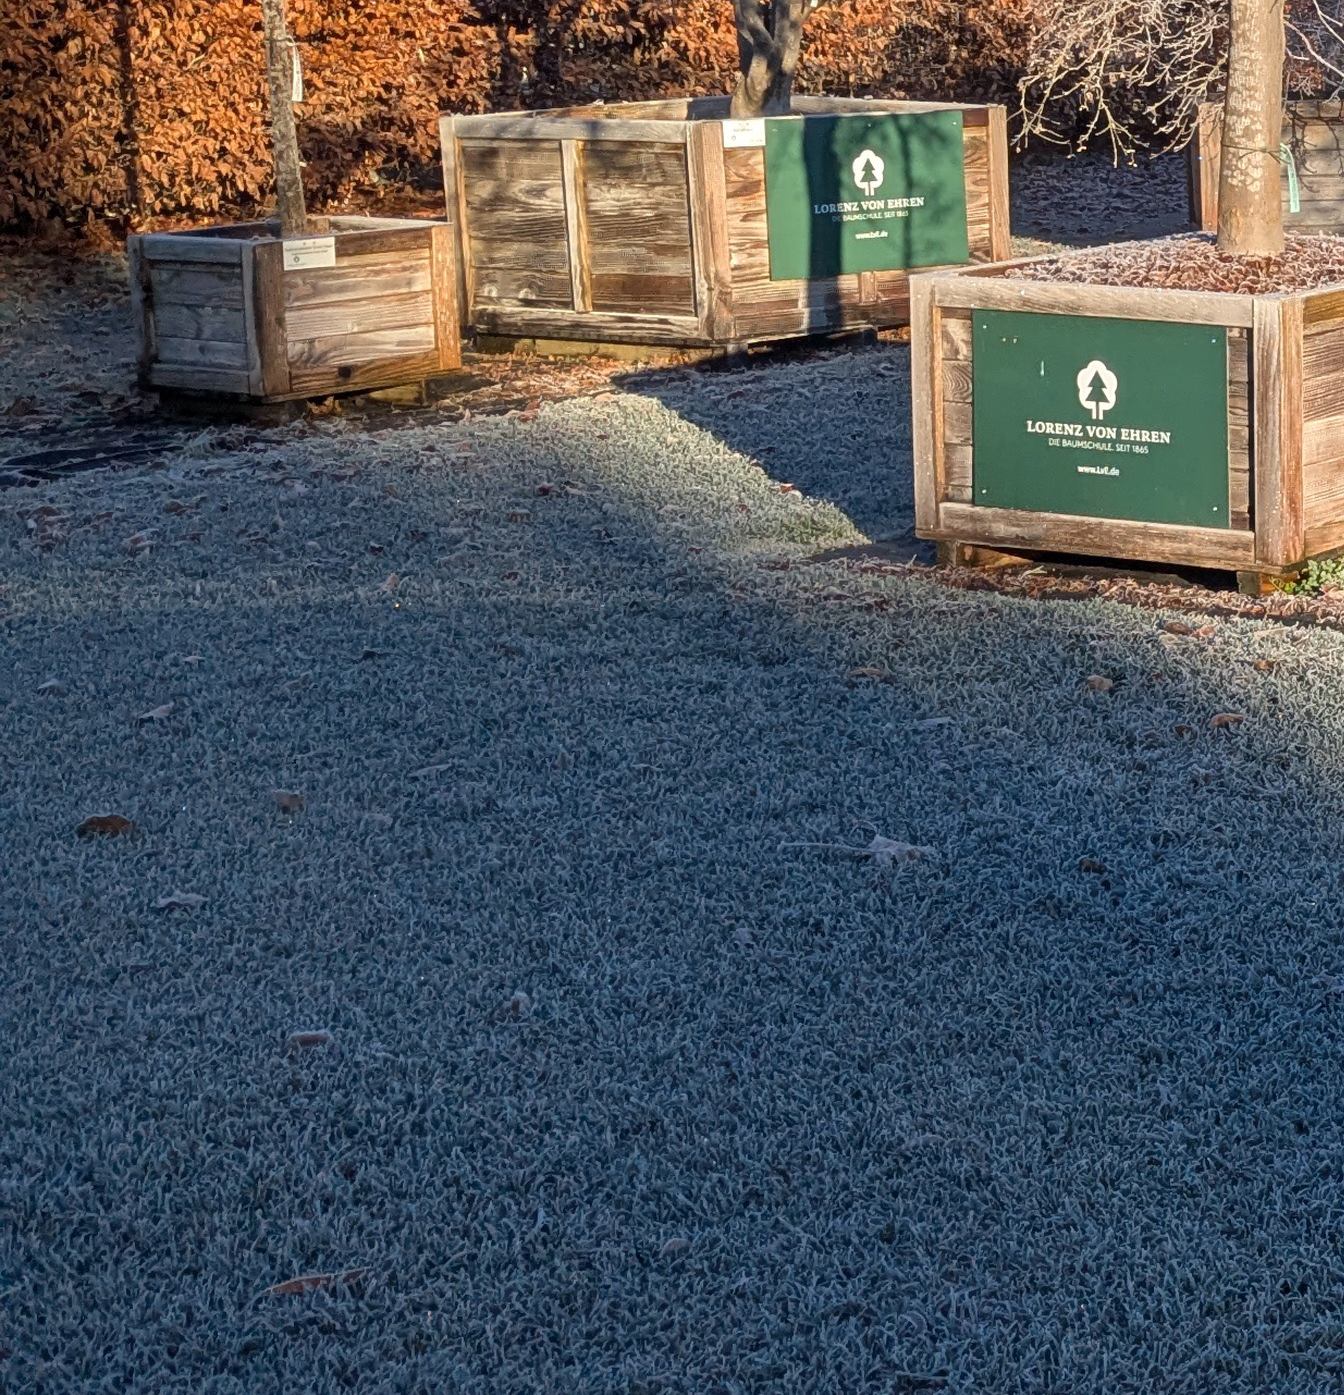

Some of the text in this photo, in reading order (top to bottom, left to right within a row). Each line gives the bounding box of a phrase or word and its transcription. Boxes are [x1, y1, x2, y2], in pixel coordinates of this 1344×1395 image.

[814, 197, 925, 214] LORENZ VON EHREN
[1026, 420, 1171, 444] LORENZ VON EHREN
[1048, 438, 1060, 447] DIE
[1116, 443, 1130, 453] SEIT
[1132, 445, 1149, 454] 1865
